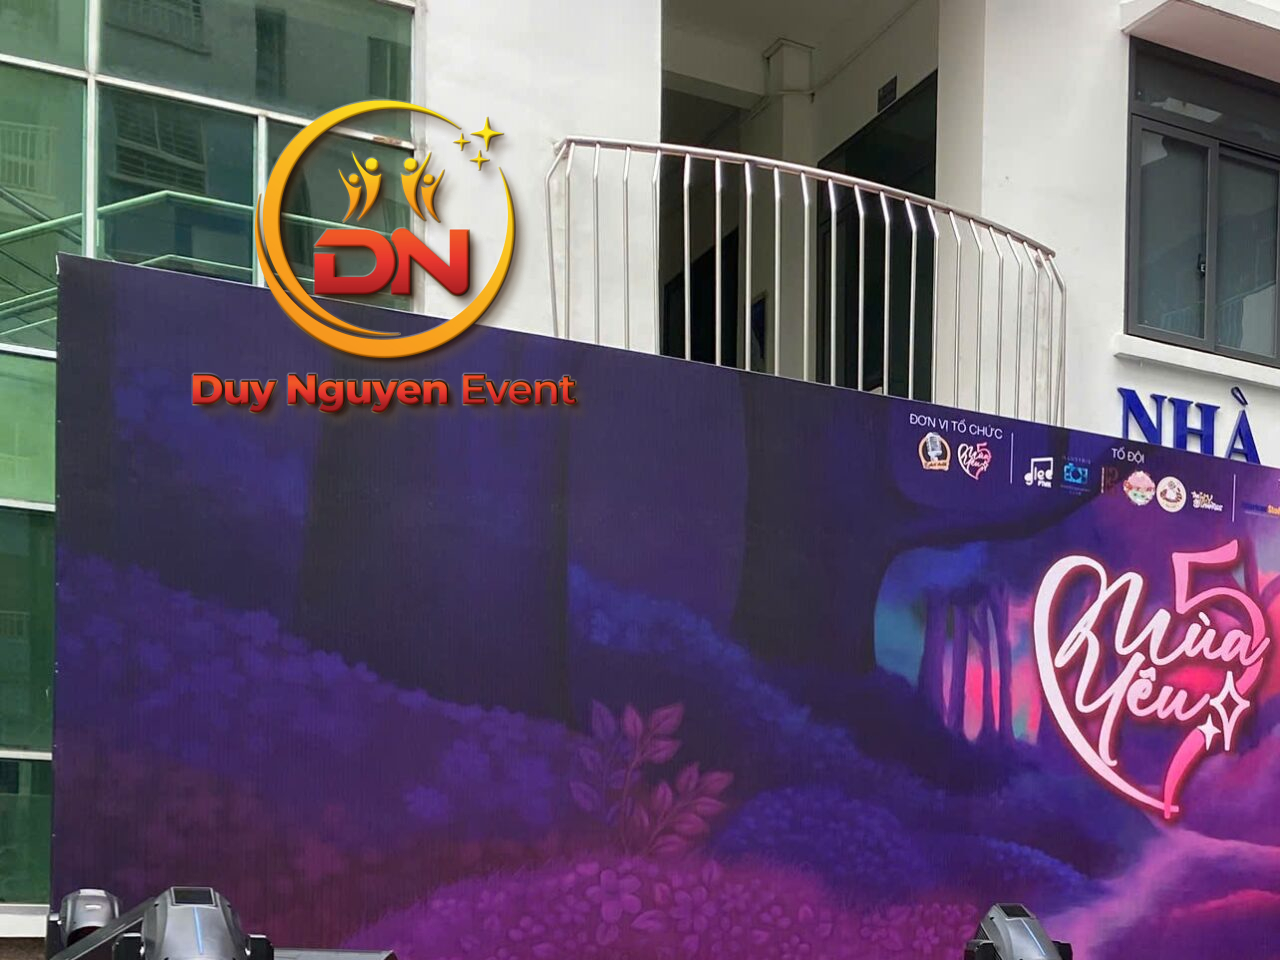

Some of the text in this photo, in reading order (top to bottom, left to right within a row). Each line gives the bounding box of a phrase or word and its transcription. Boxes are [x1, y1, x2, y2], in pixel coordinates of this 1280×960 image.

[909, 413, 1004, 440] ĐƠN VỊ TỔ CHỨC
[1112, 447, 1145, 465] TỔ ĐỘI
[1117, 386, 1262, 465] NHÀ
[1054, 570, 1271, 667] Mùa
[1057, 630, 1211, 767] Yêu
